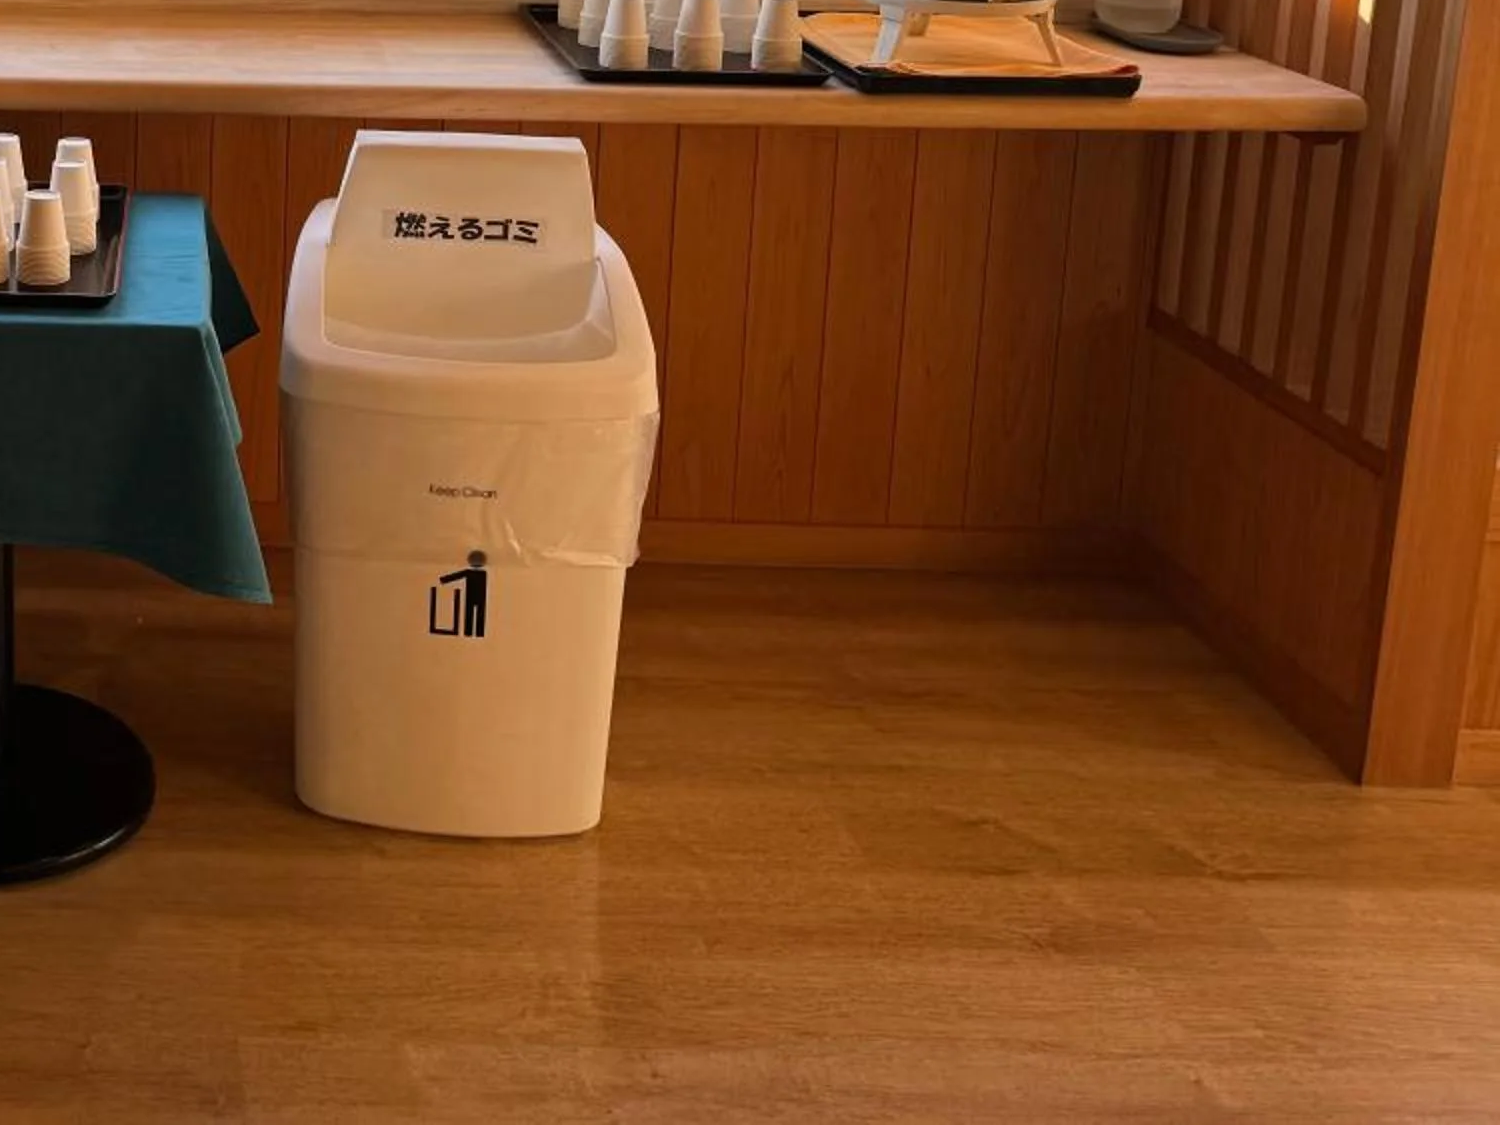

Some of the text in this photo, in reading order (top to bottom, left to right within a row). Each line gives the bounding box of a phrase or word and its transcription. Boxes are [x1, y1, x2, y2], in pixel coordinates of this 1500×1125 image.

[394, 212, 539, 244] 燃えるゴミ
